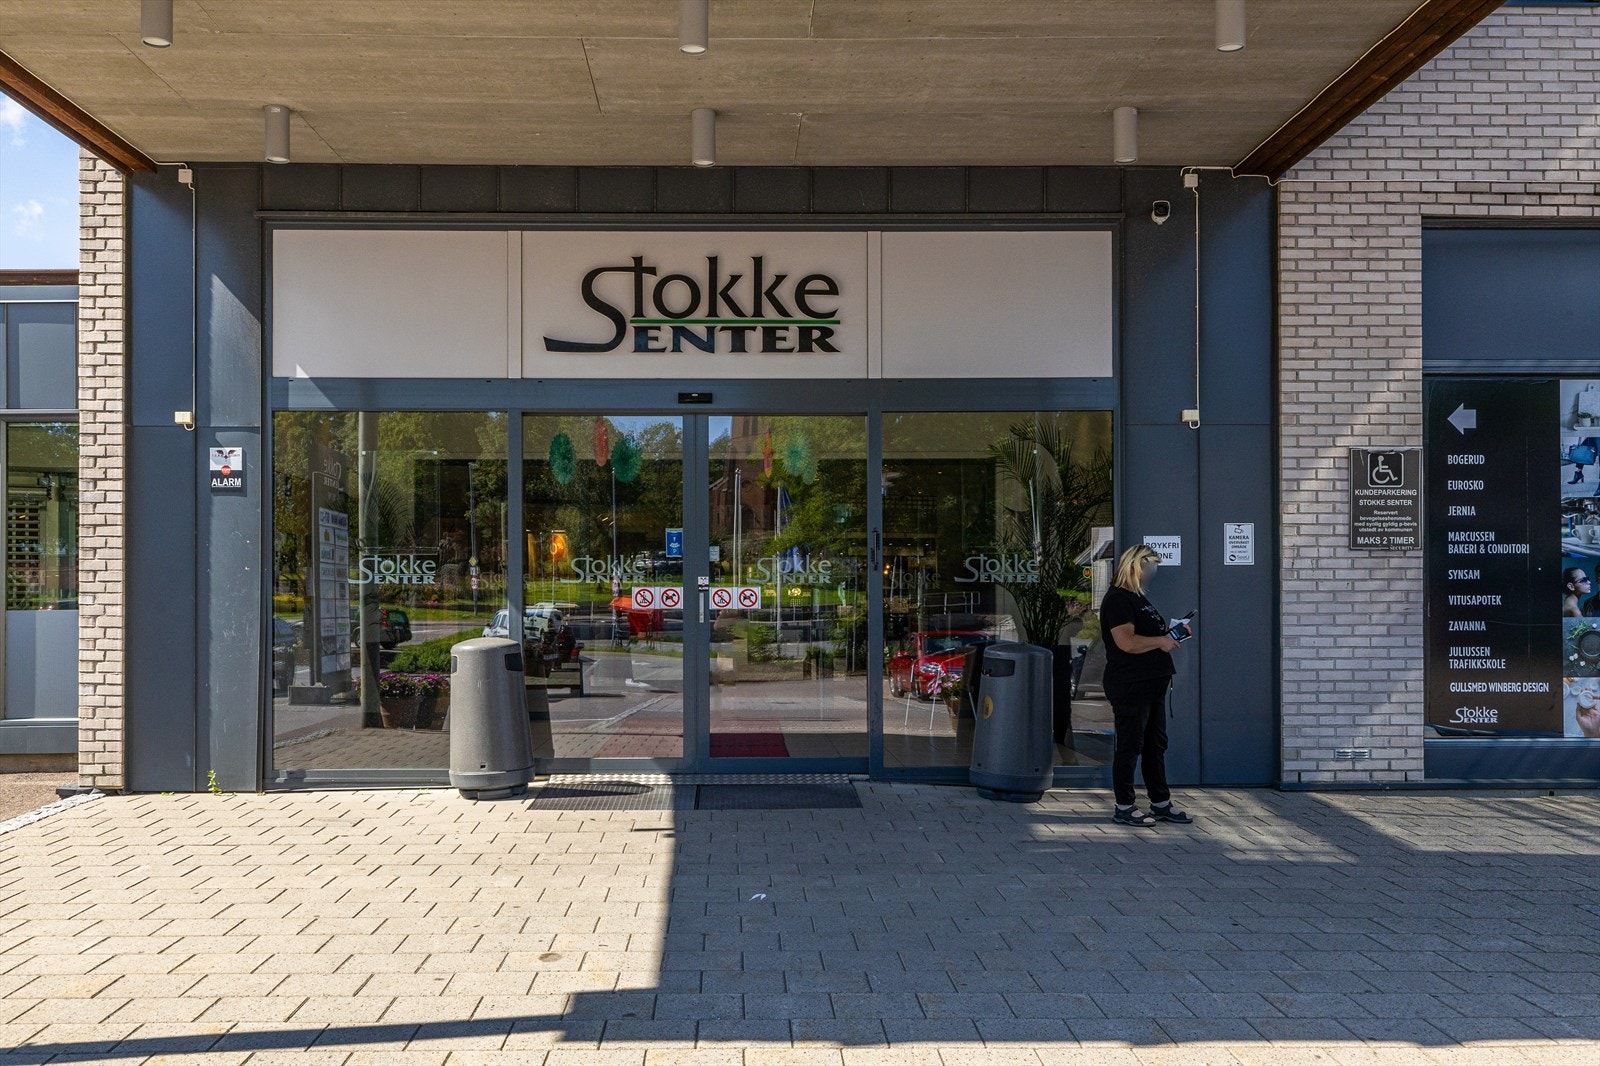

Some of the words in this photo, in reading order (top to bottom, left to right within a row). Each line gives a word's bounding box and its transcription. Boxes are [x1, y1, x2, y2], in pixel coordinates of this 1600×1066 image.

[1447, 454, 1485, 465] BOGERUD
[211, 477, 242, 486] ALARM
[1447, 480, 1484, 491] EUROSKO
[1447, 505, 1476, 516] JERNIA
[1357, 536, 1381, 544] MAKS
[1382, 536, 1388, 544] 2
[1389, 536, 1415, 544] TIMER
[1448, 531, 1495, 541] MARCUSSEN
[1448, 543, 1477, 554] BAKERI
[1479, 544, 1485, 554] &
[1487, 543, 1530, 554] CONDITORI
[348, 554, 437, 584] Stokke
[560, 554, 646, 583] Stokke
[954, 553, 1041, 583] Stokke
[1448, 569, 1480, 579] SYNSAM
[1448, 595, 1502, 605] VITUSAPOTEK
[1448, 620, 1486, 631] ZAVANNA
[1449, 646, 1490, 657] JULIUSSEN
[1449, 659, 1506, 669] TRAFIKKSKOLE
[1450, 682, 1488, 693] GULLSMED
[1488, 682, 1522, 693] WINBERG
[1522, 682, 1549, 693] DESIGN
[1450, 706, 1499, 723] Stokke
